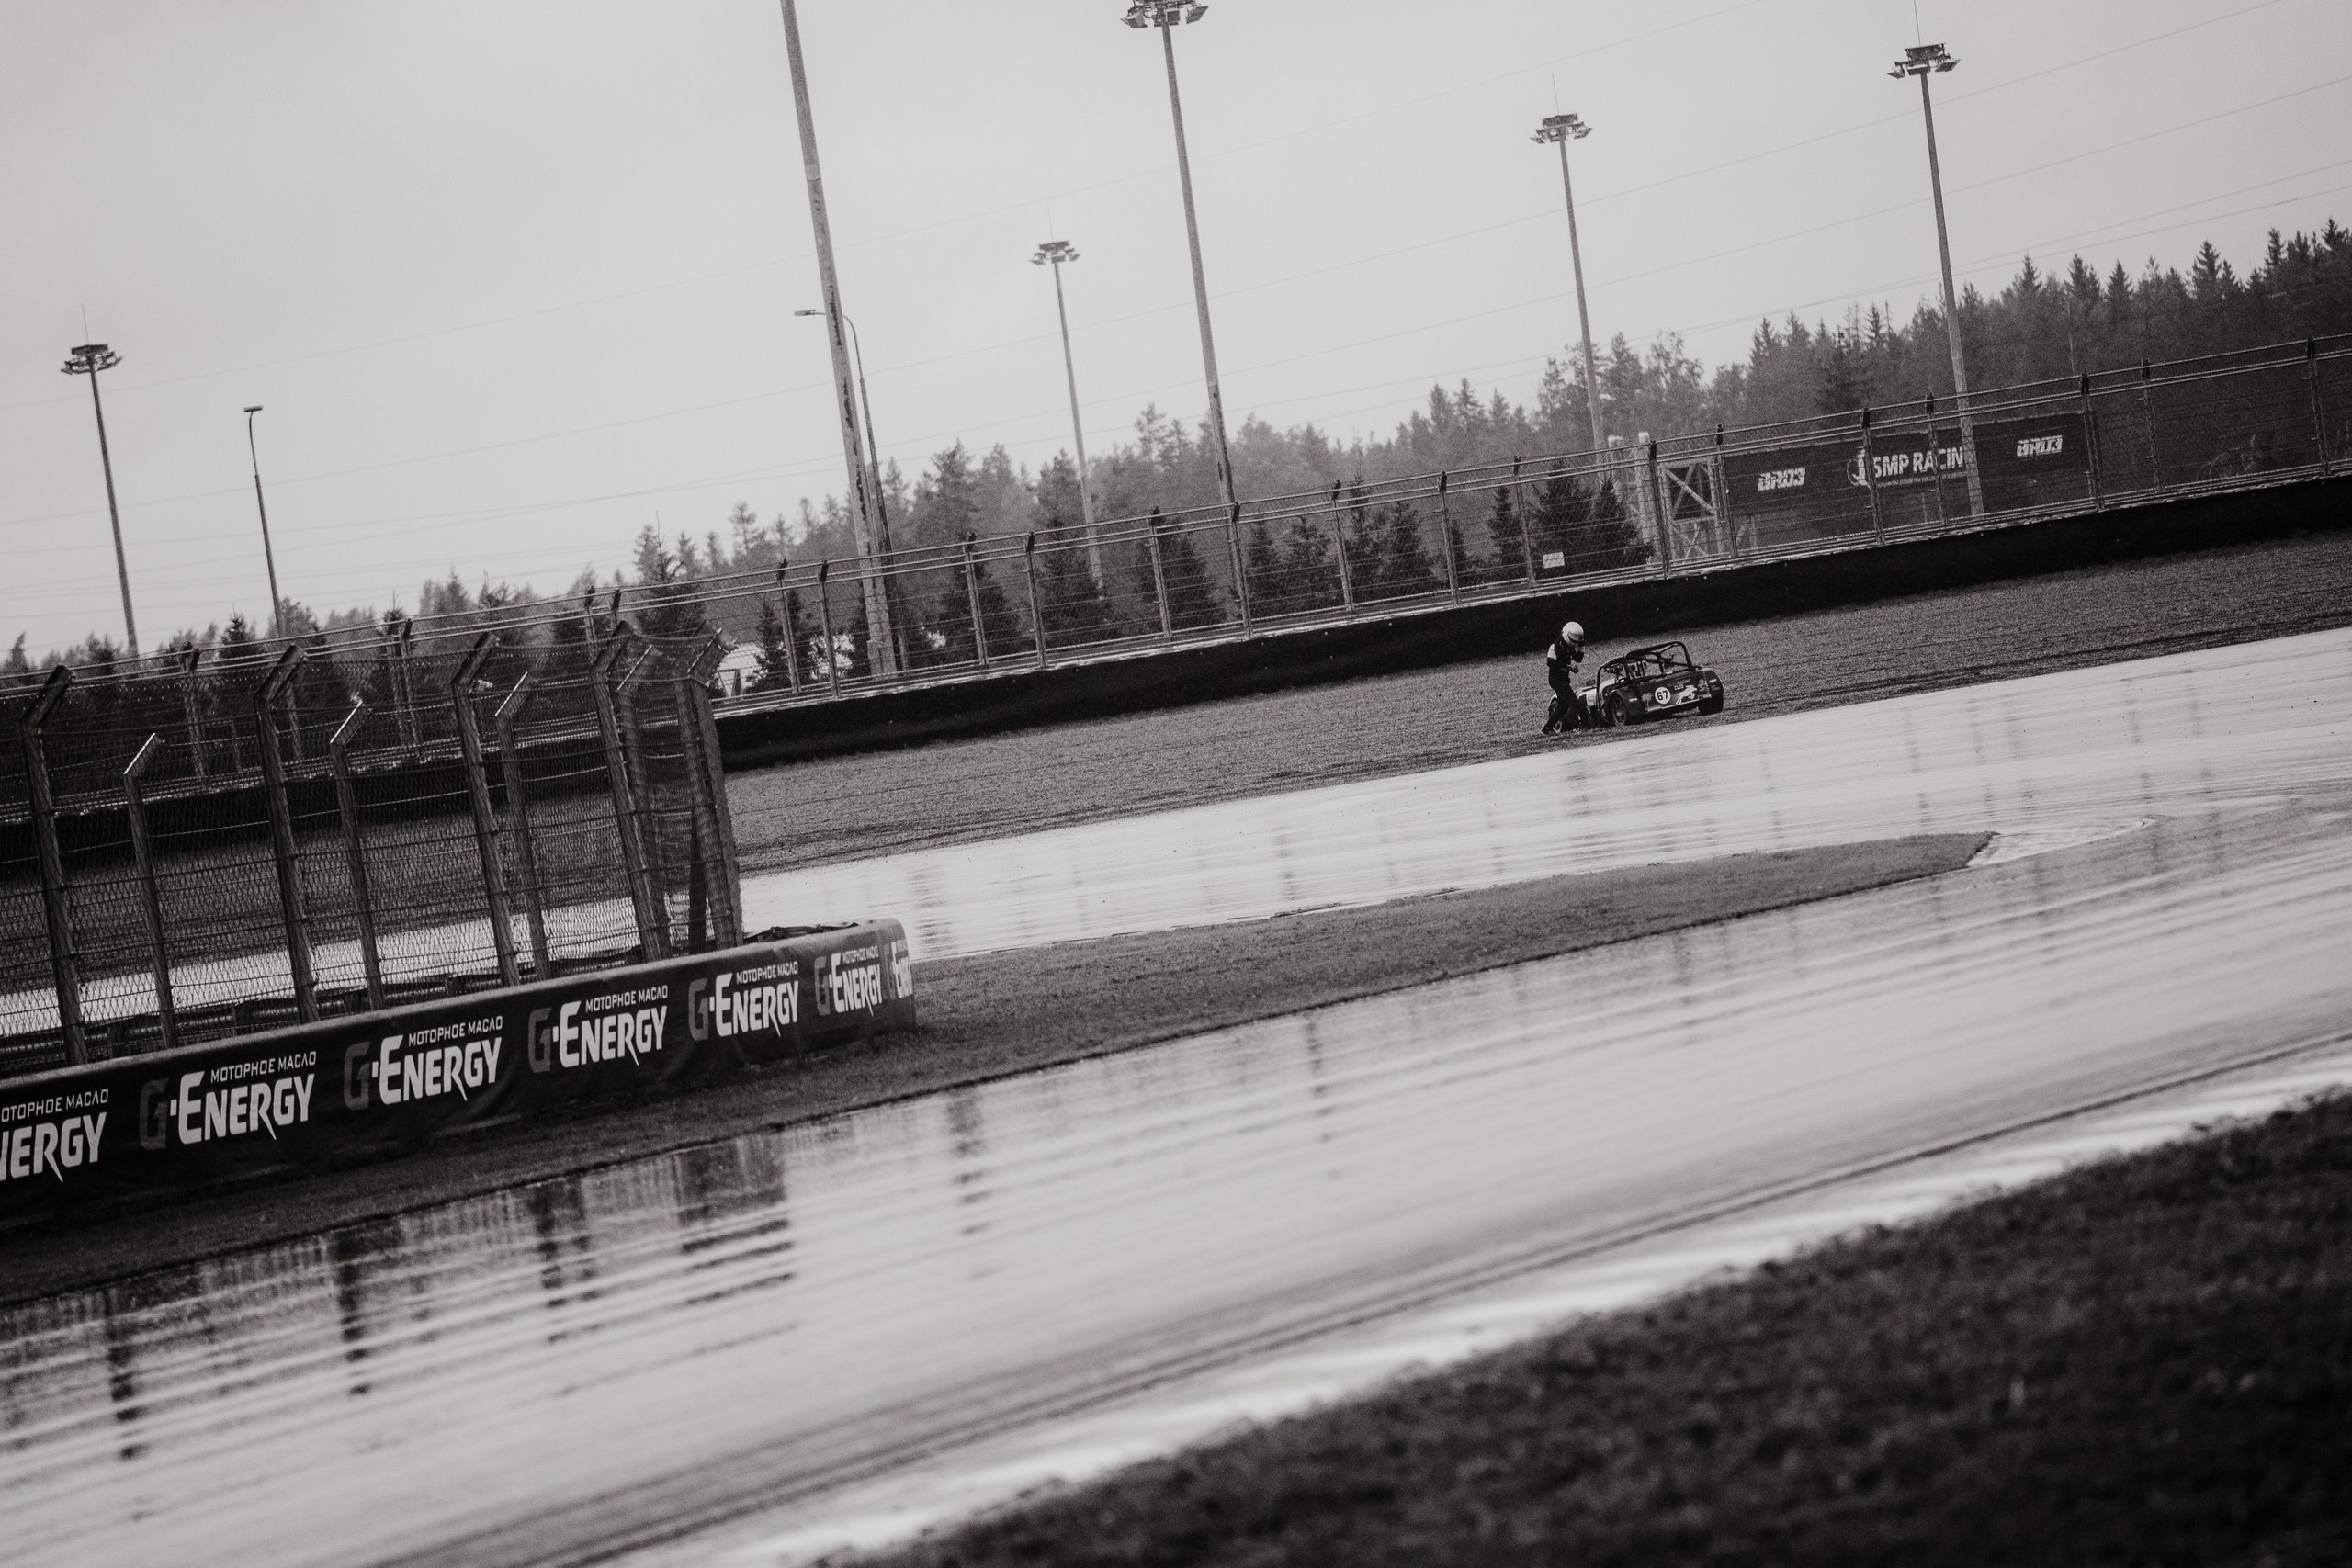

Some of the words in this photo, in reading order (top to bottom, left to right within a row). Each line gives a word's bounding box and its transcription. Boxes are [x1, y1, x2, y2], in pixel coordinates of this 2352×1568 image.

[1872, 453, 1910, 479] SMP
[1913, 446, 1964, 474] RACIN
[1657, 691, 1668, 701] 67
[736, 964, 777, 985] МОТОРНОЕ
[814, 953, 883, 1016] G-ENERGY
[586, 991, 637, 1012] МОТОРНОЕ
[639, 986, 668, 1003] МАСЛО
[688, 973, 799, 1041] G-ENERGY
[409, 1020, 466, 1046] МОТОРНОЕ
[468, 1014, 503, 1034] МАСЛО
[528, 1001, 668, 1073] G-ENERGY
[210, 1059, 276, 1084] МОТОРНОЕ
[277, 1050, 317, 1073] МАСЛО
[343, 1034, 503, 1111] G-ENERGY
[1, 1097, 63, 1122] ОТОРНОЕ
[65, 1088, 109, 1110] МАСЛО
[139, 1071, 315, 1150] G-ENERGY
